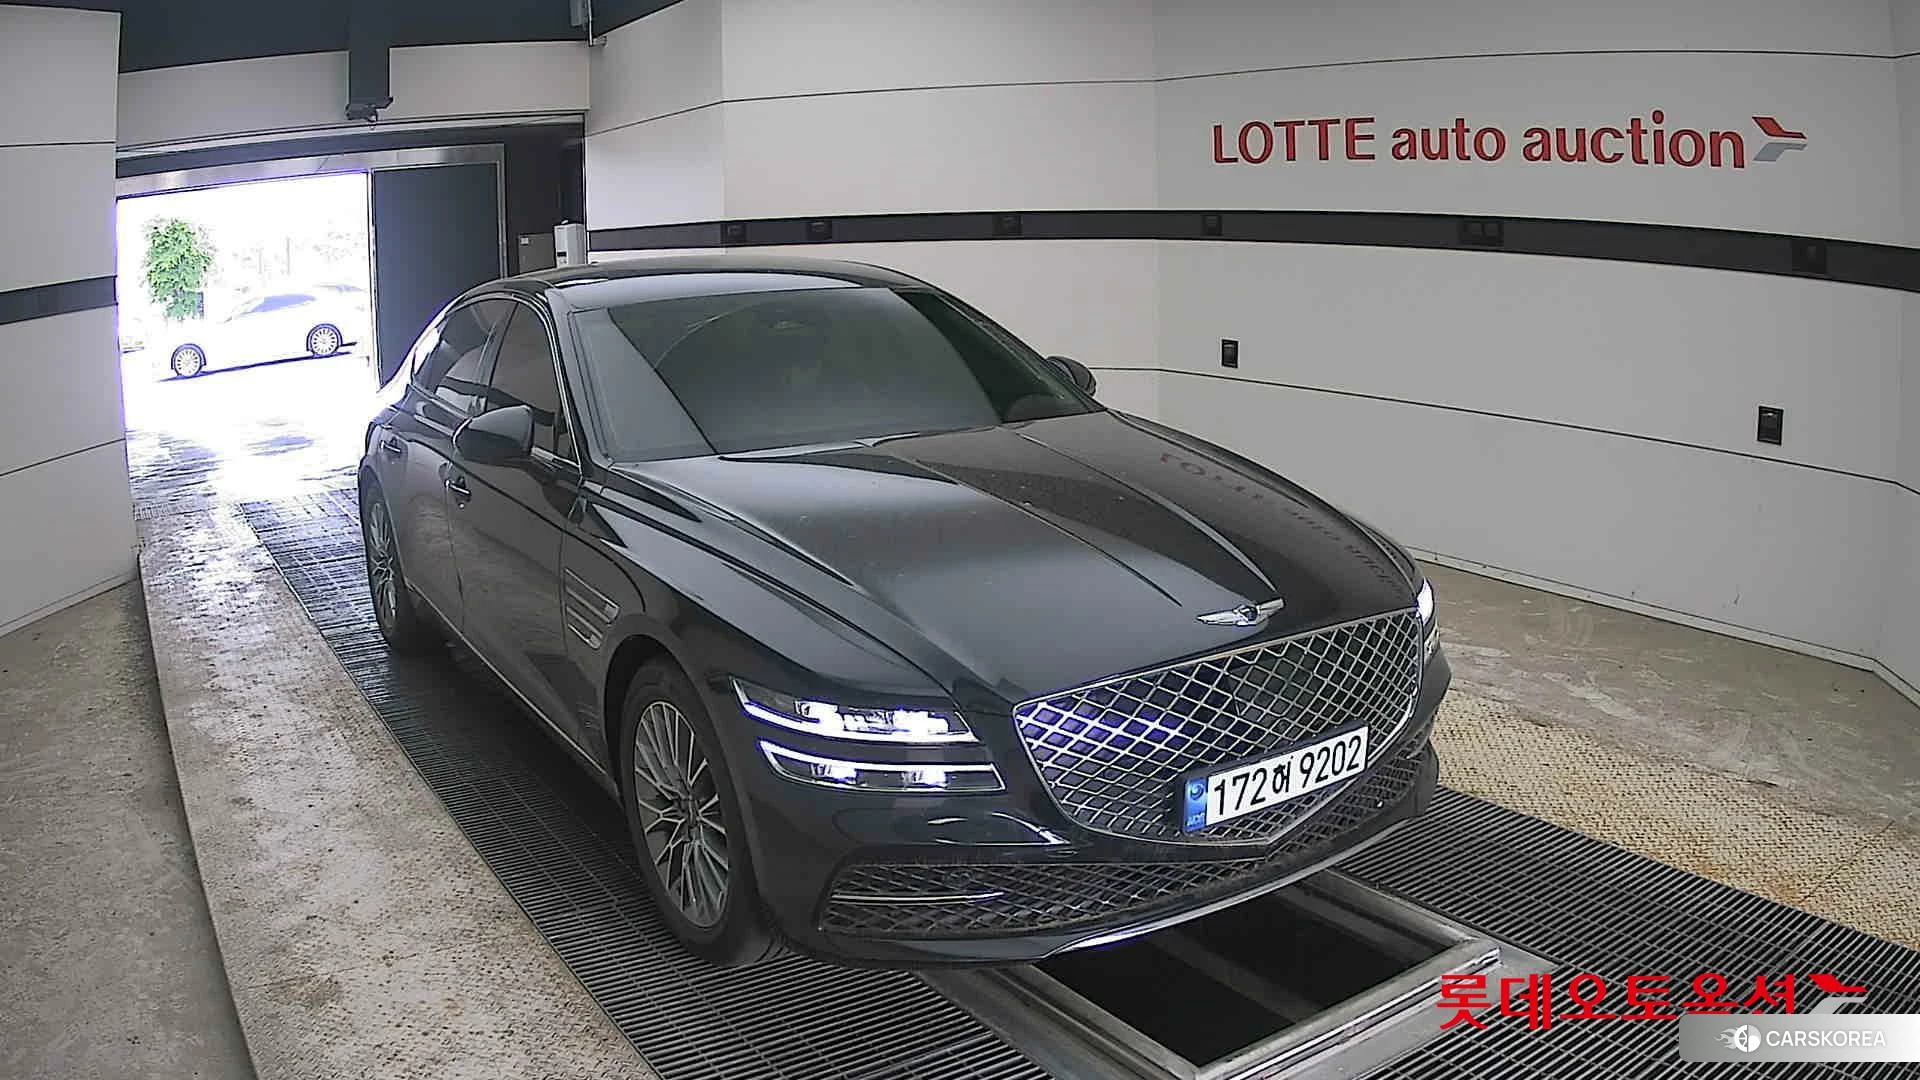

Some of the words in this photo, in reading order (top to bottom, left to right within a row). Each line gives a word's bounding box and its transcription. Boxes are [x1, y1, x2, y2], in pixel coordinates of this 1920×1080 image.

[1213, 116, 1376, 164] LOTTE
[1391, 117, 1506, 162] auto
[1523, 109, 1746, 169] auction
[1299, 734, 1362, 789] 9202
